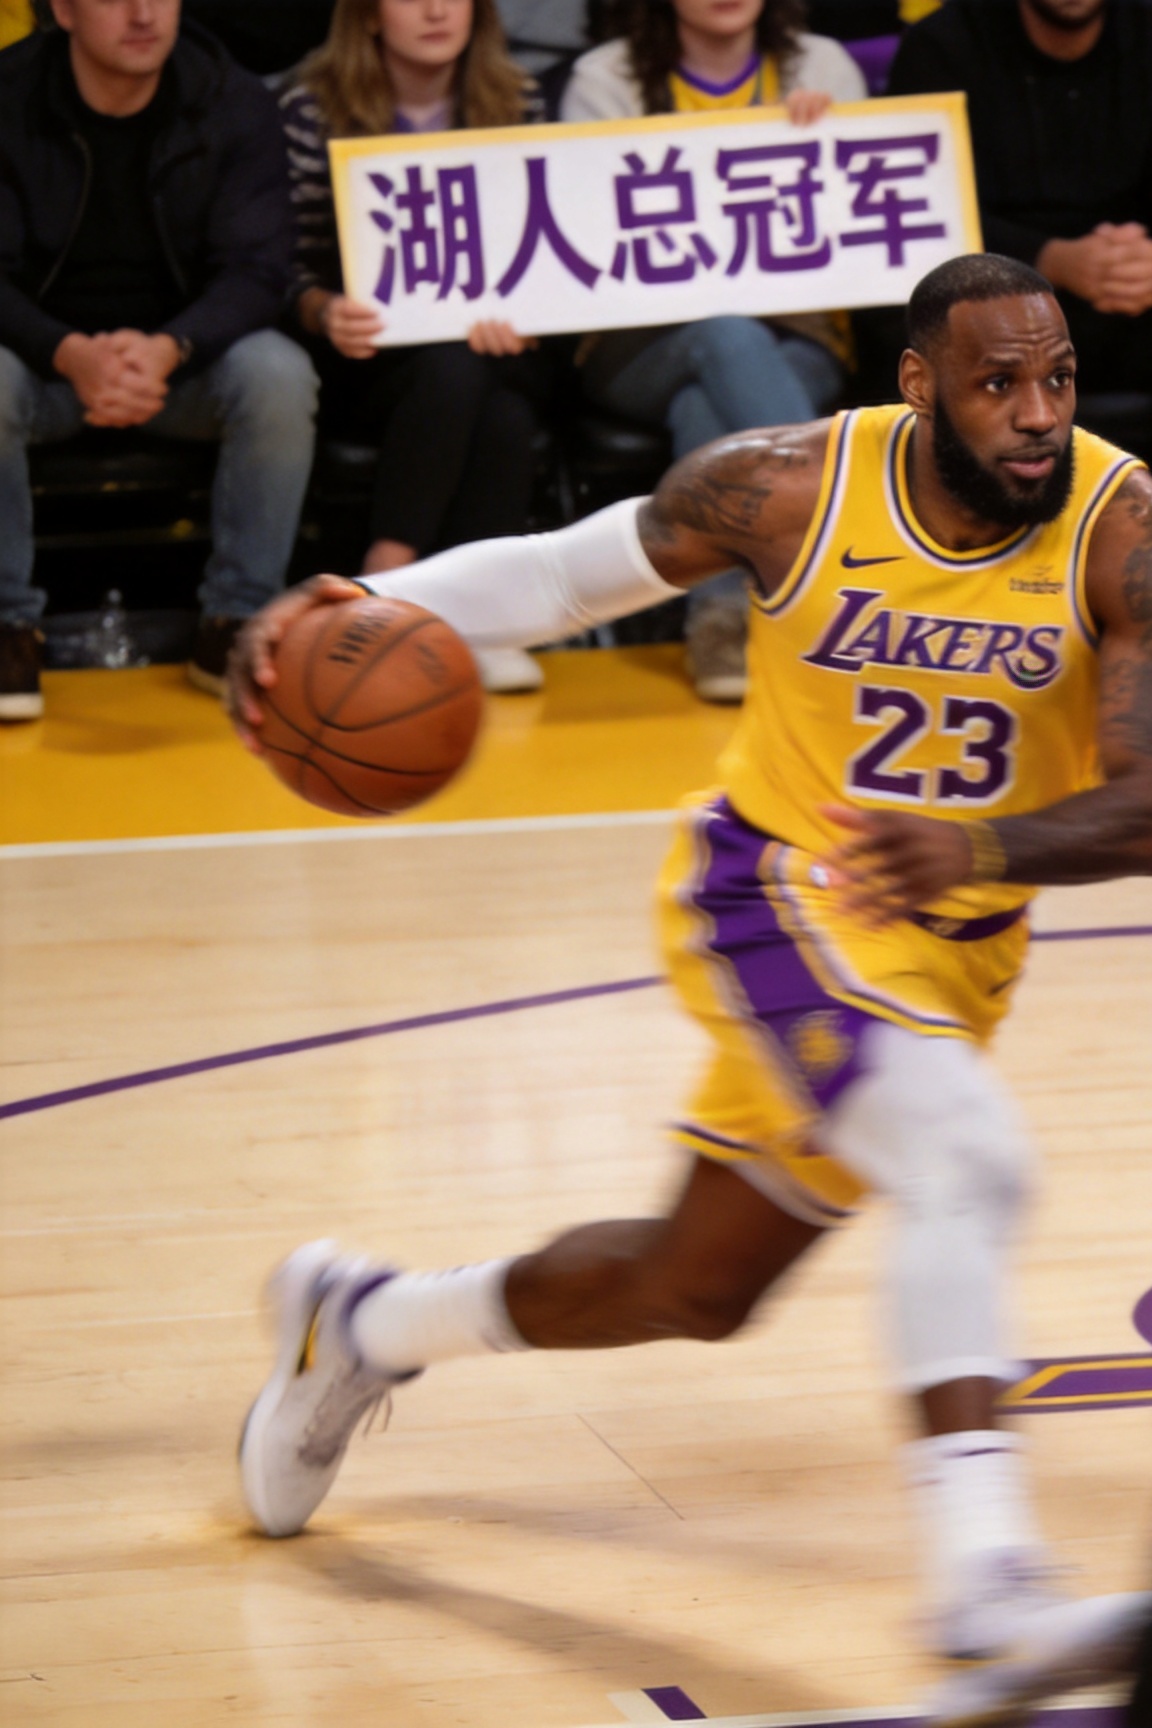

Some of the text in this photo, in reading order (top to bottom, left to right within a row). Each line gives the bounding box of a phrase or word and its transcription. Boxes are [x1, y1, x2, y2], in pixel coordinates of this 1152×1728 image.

[366, 131, 947, 305] 湖人总冠军
[800, 588, 1066, 691] LAKERS
[845, 683, 1017, 808] 23
